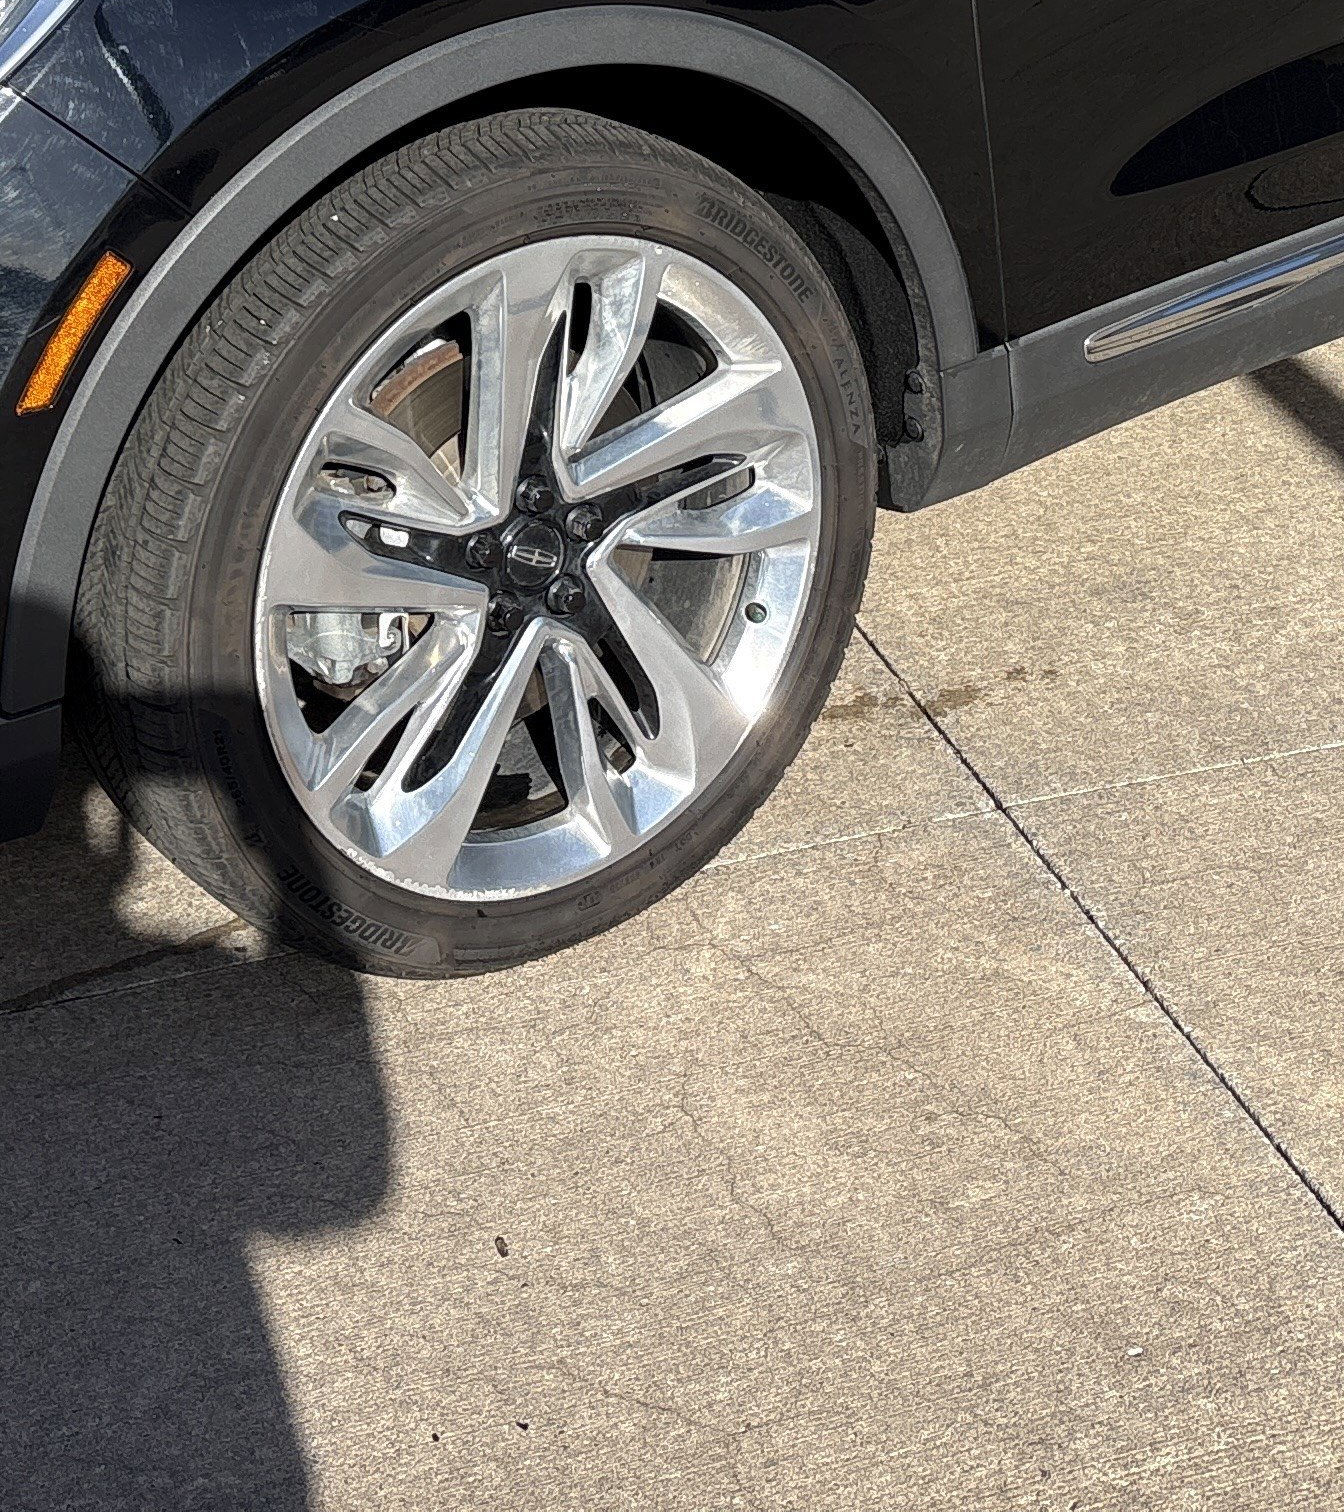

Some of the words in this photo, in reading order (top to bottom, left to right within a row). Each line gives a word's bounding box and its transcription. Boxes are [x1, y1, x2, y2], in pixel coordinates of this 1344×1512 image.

[694, 193, 814, 304] BRIDGESTONE
[832, 357, 861, 436] ALENZA
[277, 864, 417, 956] BRIDGESTONE
